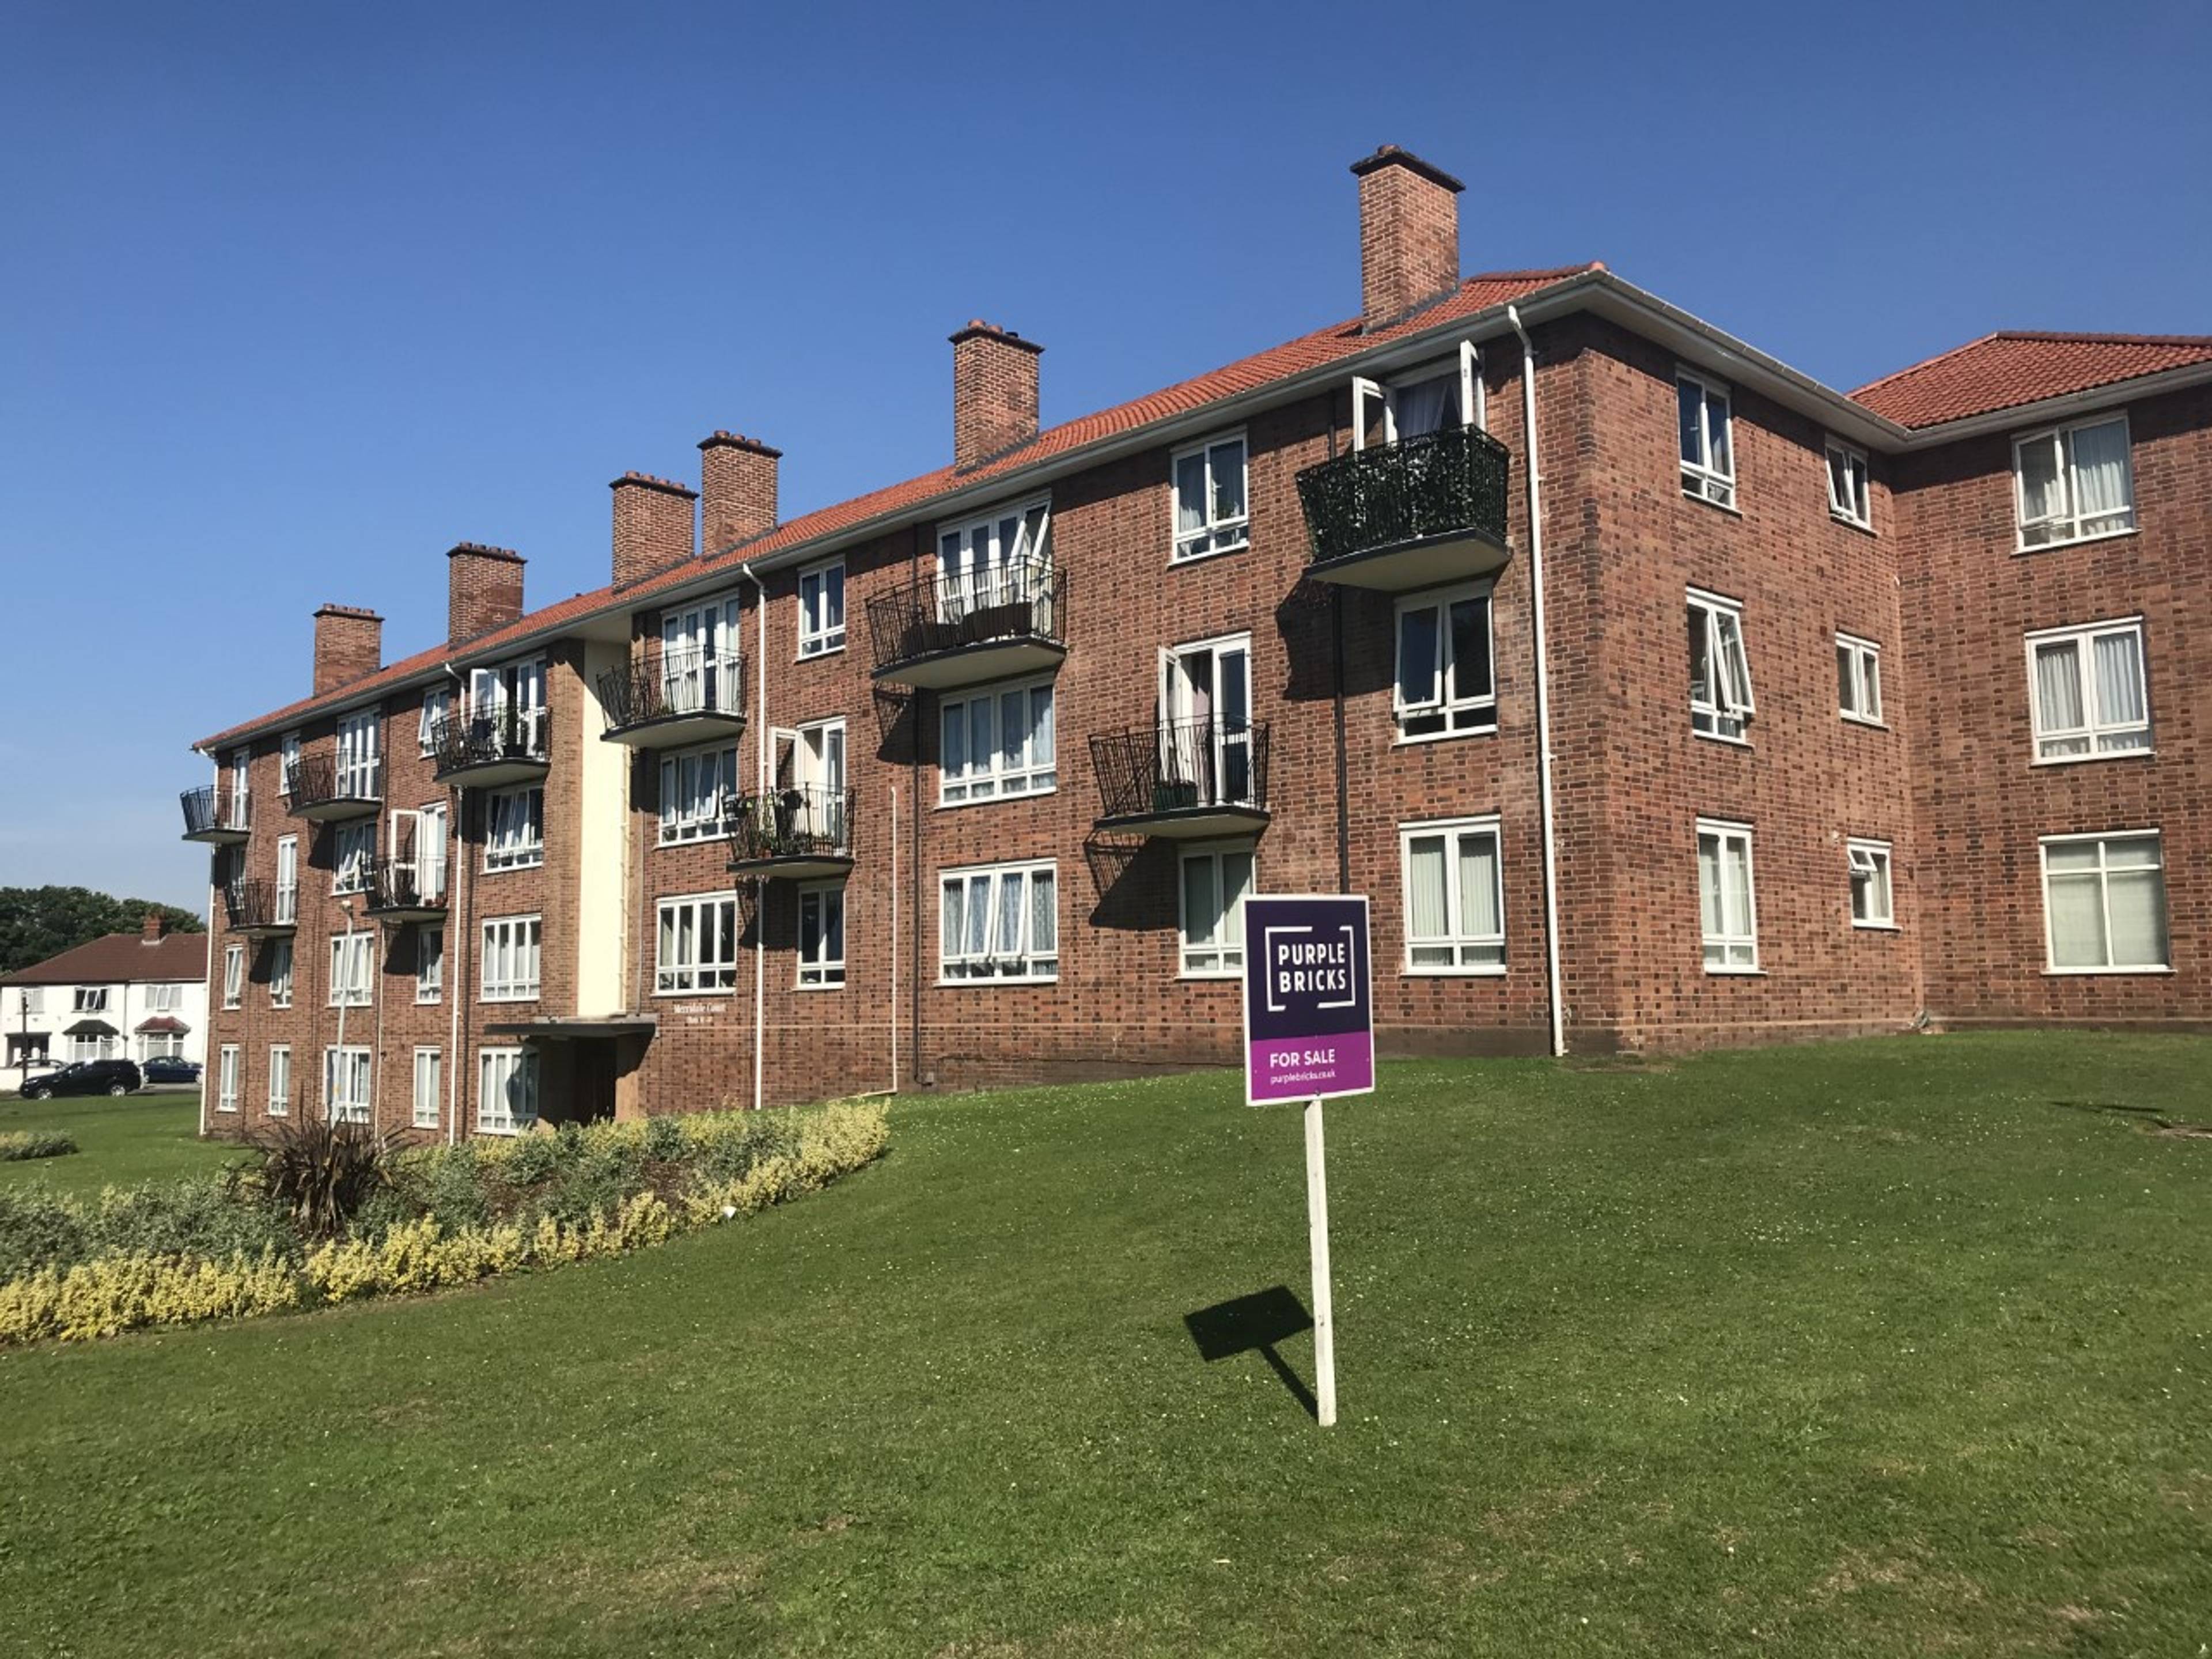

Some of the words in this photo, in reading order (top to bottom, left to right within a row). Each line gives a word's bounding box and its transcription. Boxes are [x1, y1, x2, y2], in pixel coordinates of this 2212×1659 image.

[1278, 942, 1346, 965] PURPLE
[1279, 969, 1346, 993] BRICKS
[1270, 1052, 1300, 1068] FOR
[1304, 1048, 1335, 1066] SALE
[1270, 1069, 1336, 1085] purplebricks.co.uk
